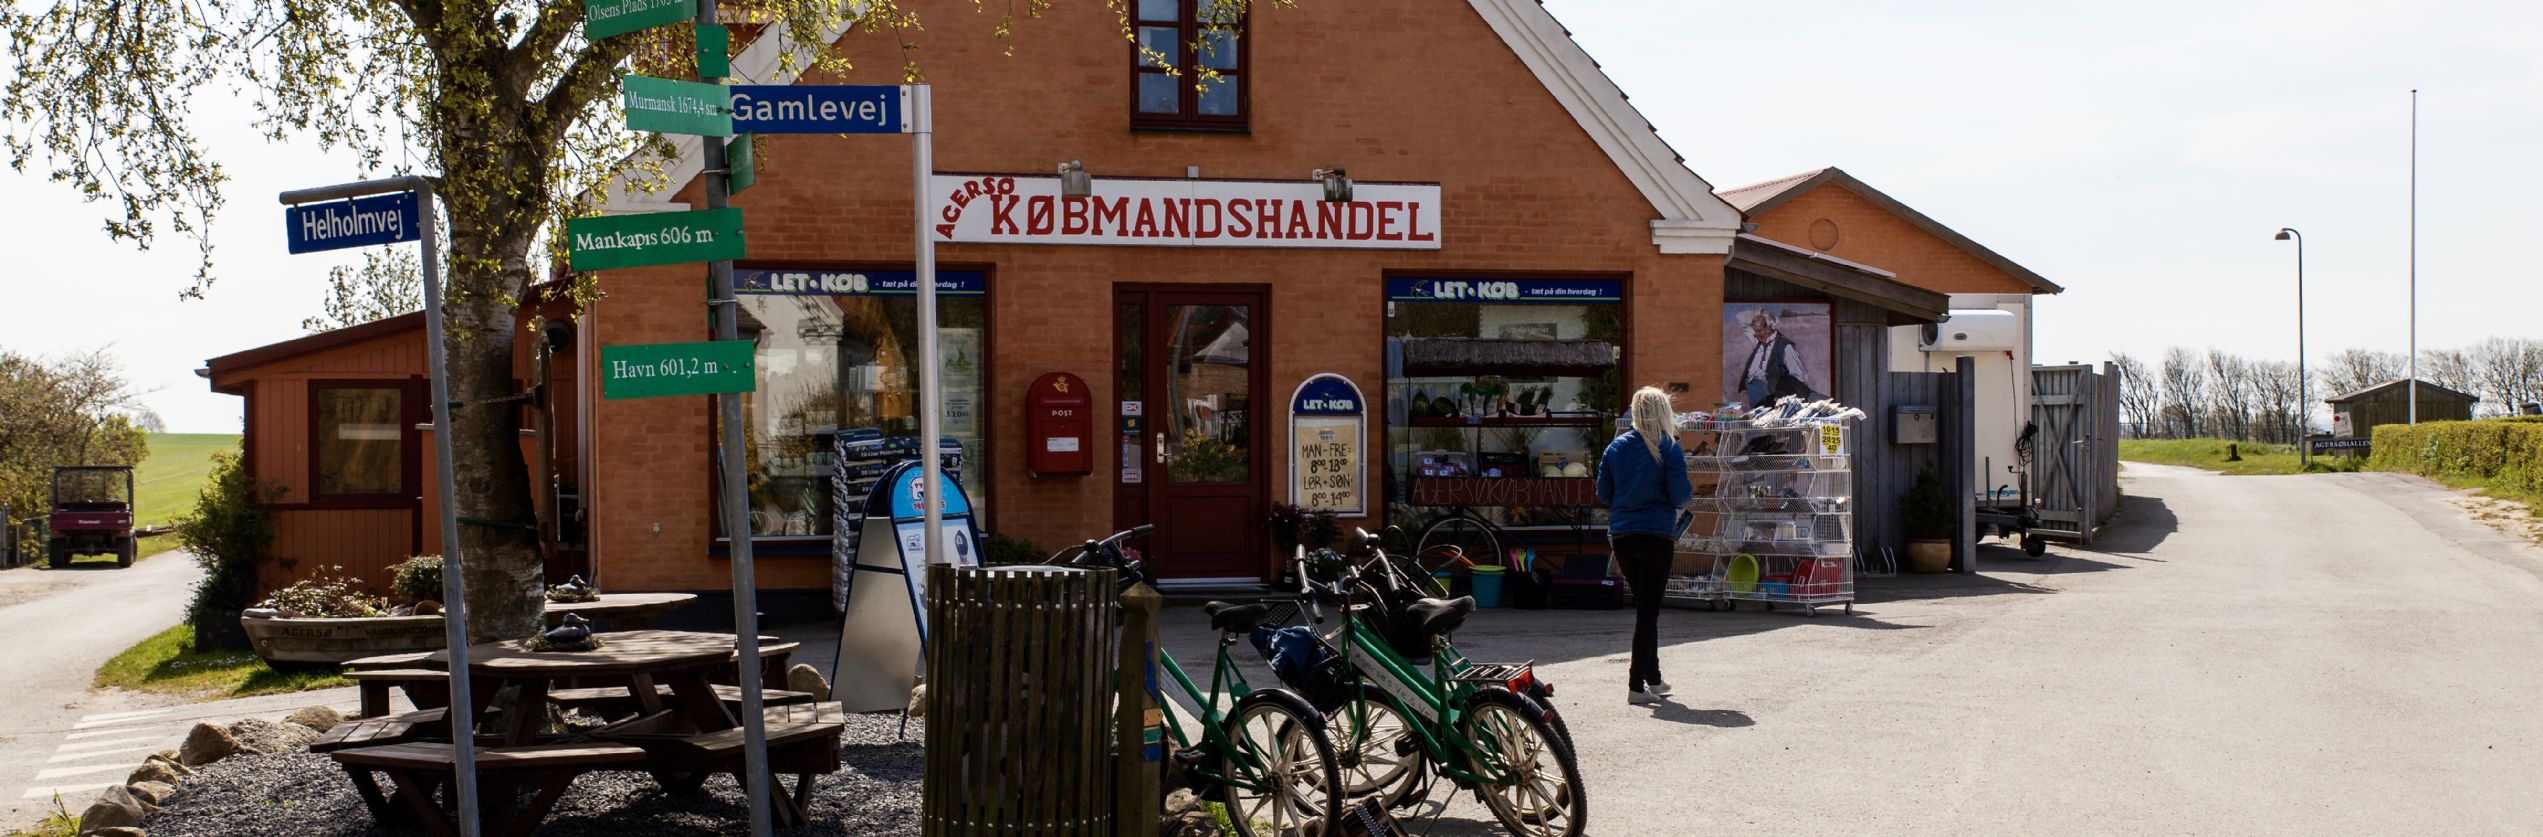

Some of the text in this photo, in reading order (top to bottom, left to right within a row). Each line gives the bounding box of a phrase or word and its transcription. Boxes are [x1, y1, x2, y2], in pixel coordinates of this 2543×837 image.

[589, 4, 620, 21] Olsens
[622, 0, 648, 14] Plads
[629, 91, 718, 117] Murmansk 1674,4 sm
[730, 93, 887, 127] Gamlevej
[936, 176, 1015, 240] AGERSØ
[990, 194, 1434, 242] KØBMANDSHANDEL
[302, 200, 404, 242] Helholmvej
[660, 226, 692, 245] 606
[695, 229, 714, 243] m
[882, 280, 897, 288] tæt
[897, 279, 909, 291] på
[1544, 287, 1554, 297] på
[1555, 287, 1567, 295] din
[1567, 288, 1596, 297] hverdag
[612, 357, 719, 379] Havn 601,2 m
[1832, 426, 1840, 434] 15
[1302, 444, 1322, 458] MAN
[1303, 475, 1322, 490] LØR
